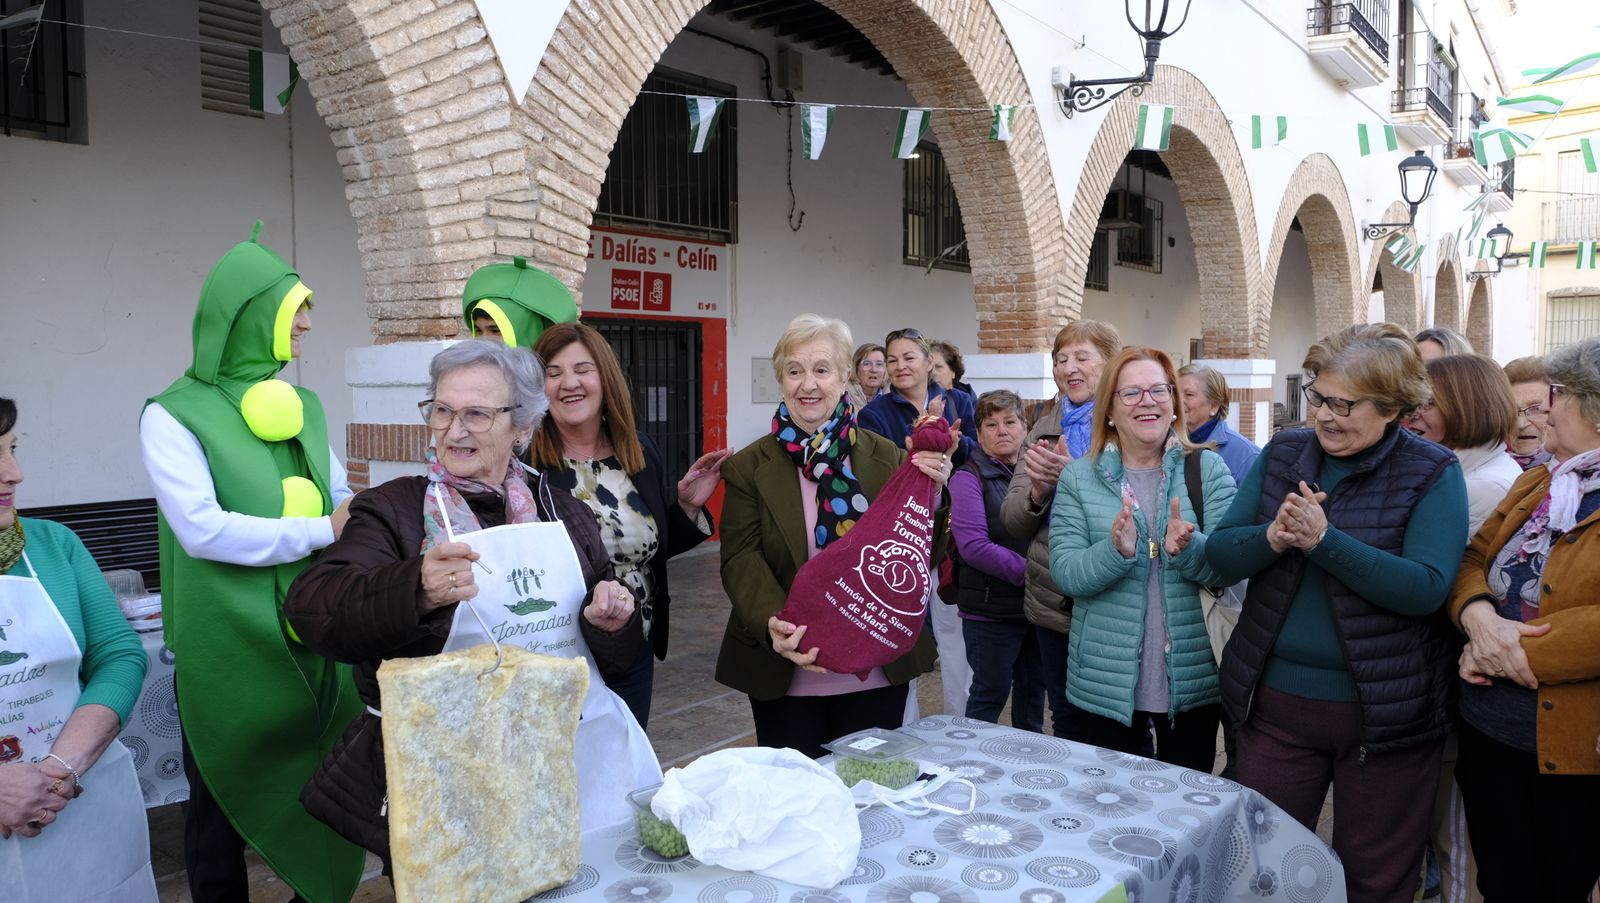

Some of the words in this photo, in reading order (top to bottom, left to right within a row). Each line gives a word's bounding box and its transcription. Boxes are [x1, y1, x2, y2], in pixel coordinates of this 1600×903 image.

[602, 236, 656, 265] Dalías
[677, 245, 717, 271] Celín
[613, 287, 639, 302] PSOE
[897, 511, 905, 519] y
[834, 577, 865, 604] Jamón
[866, 601, 878, 612] de
[878, 609, 888, 619] la
[888, 616, 913, 637] Sierra
[847, 602, 861, 614] de
[861, 611, 889, 634] María
[491, 613, 573, 644] Jornadas
[7, 689, 54, 710] TIRABEQUES
